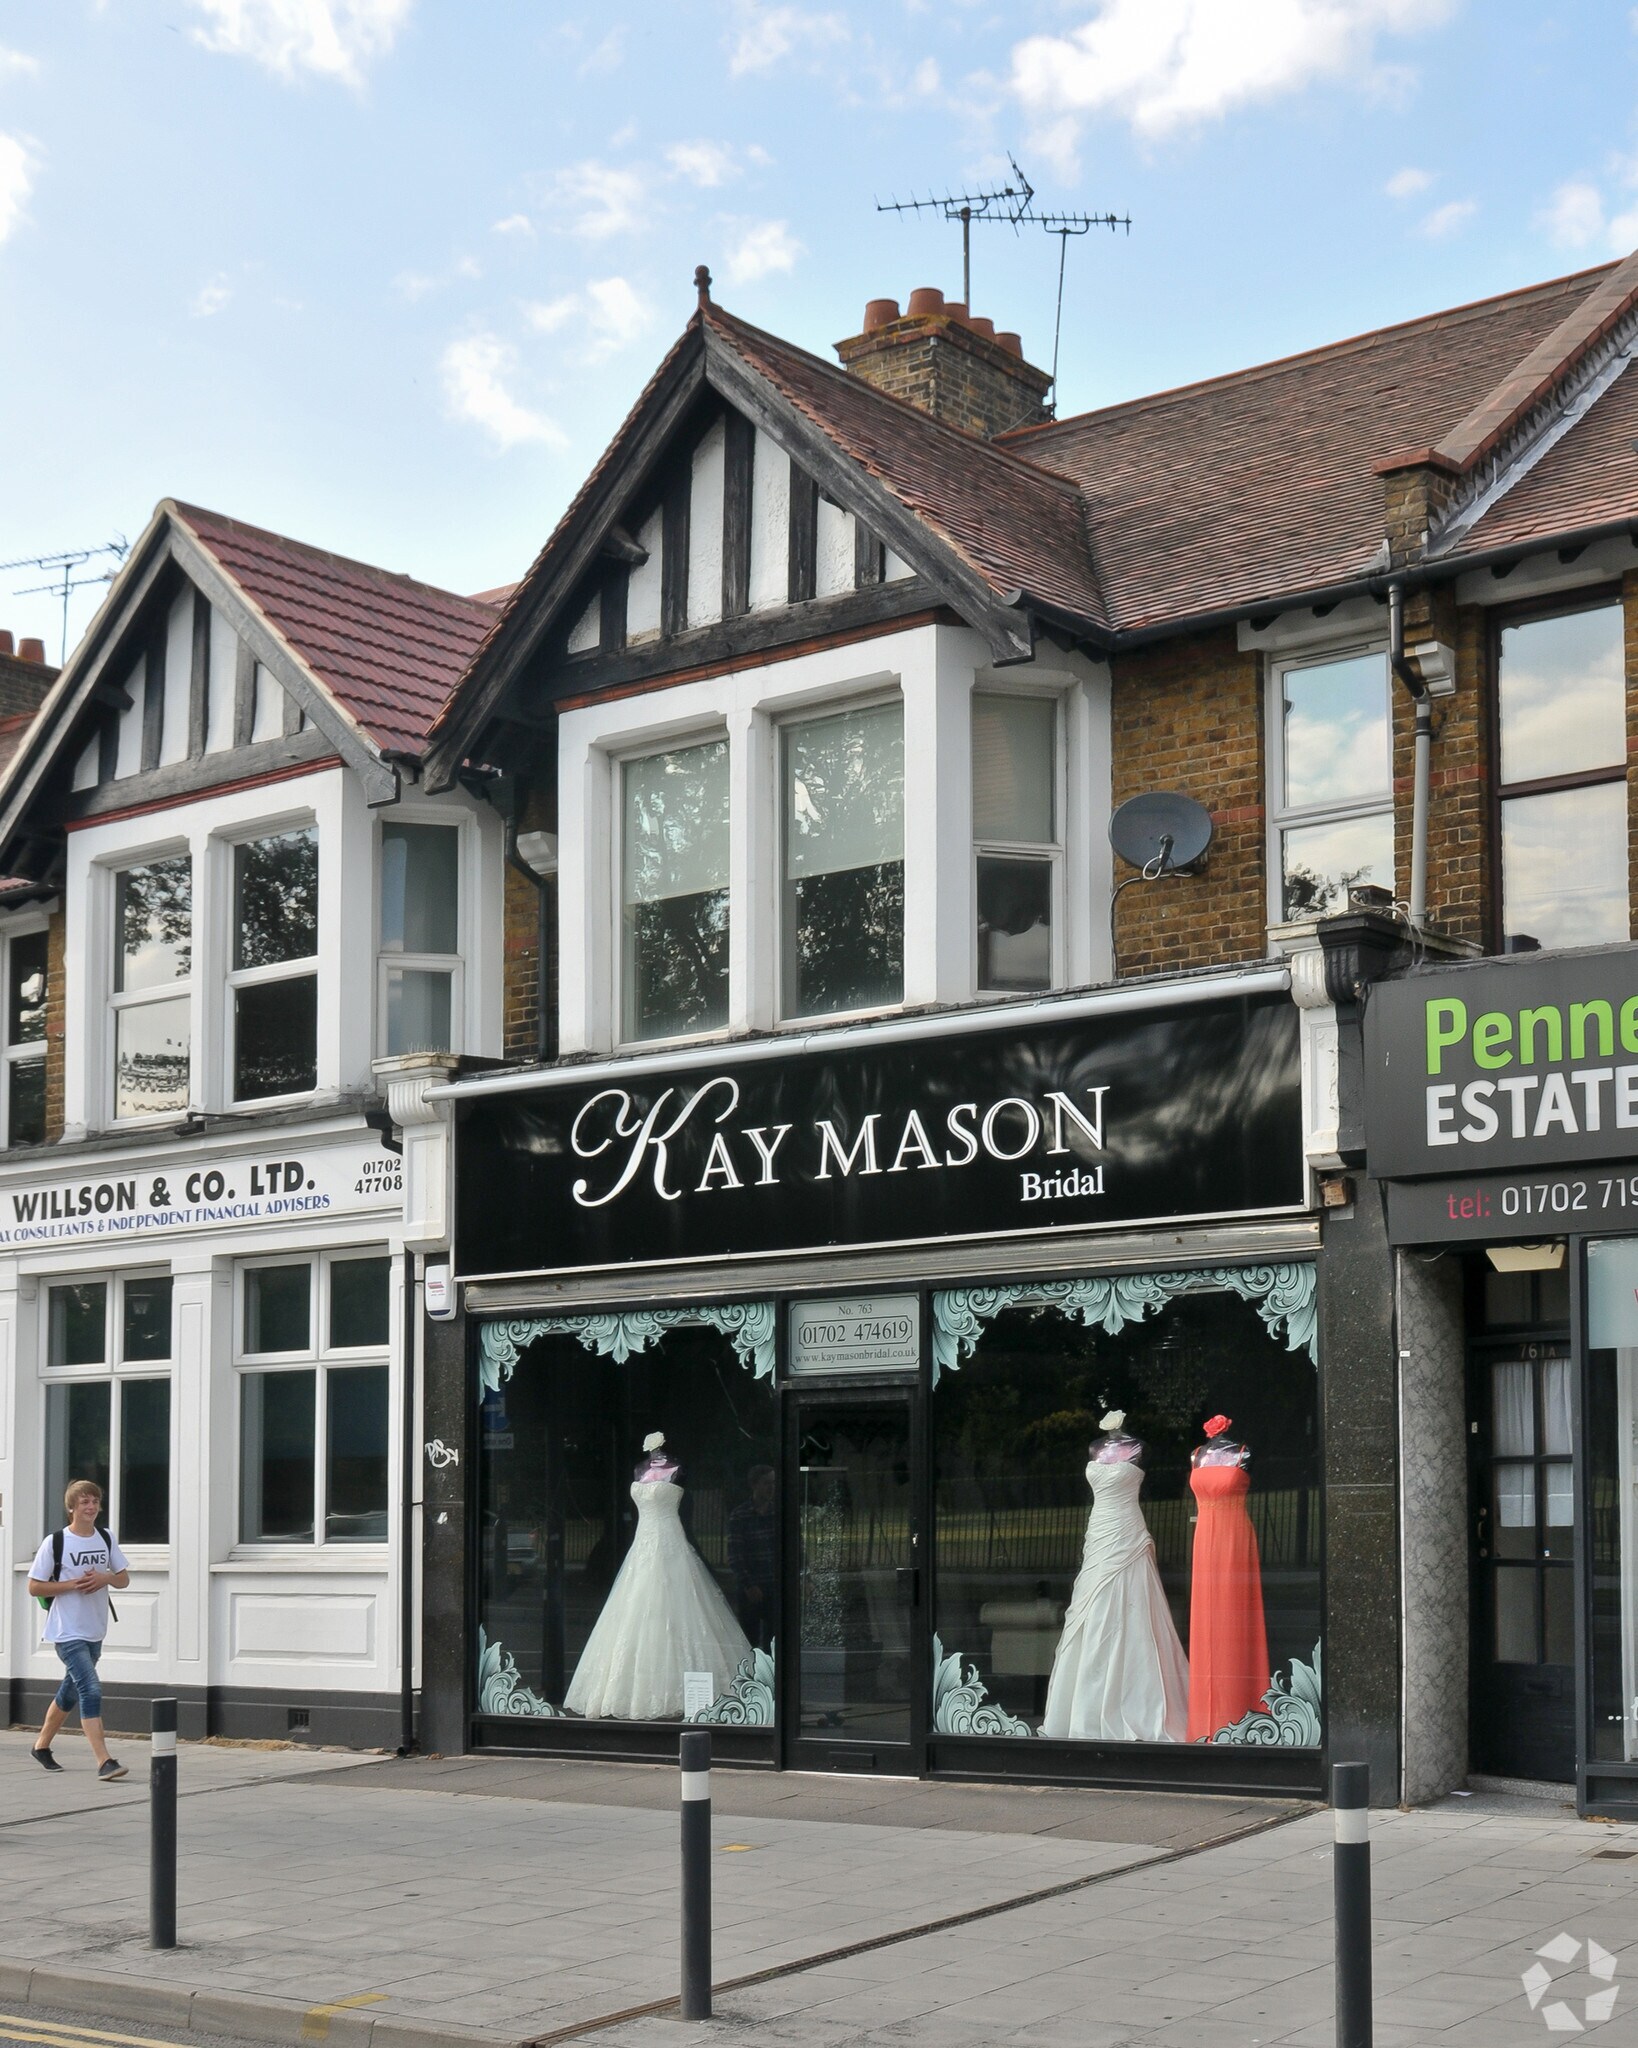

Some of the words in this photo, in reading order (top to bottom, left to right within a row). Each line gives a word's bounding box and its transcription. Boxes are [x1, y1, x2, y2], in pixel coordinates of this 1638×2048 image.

[1426, 1065, 1638, 1146] ESTATE
[814, 1086, 1111, 1181] MASON
[363, 1159, 401, 1175] 01702
[1020, 1165, 1105, 1201] Bridal
[13, 1181, 136, 1223] WILLSON
[149, 1177, 172, 1207] &
[186, 1171, 236, 1204] CO.
[250, 1161, 315, 1196] LTD.
[1447, 1188, 1491, 1219] tel:
[1501, 1181, 1588, 1216] 01702
[14, 1220, 94, 1241] CONSULTANTS
[97, 1219, 104, 1232] &
[108, 1210, 192, 1231] INDEPENDENT
[196, 1202, 261, 1221] FINANCIAL
[264, 1193, 331, 1214] ADVISERS
[838, 1306, 854, 1316] No.
[858, 1303, 873, 1314] 763
[803, 1325, 845, 1344] 01702
[854, 1320, 908, 1340] 474619
[795, 1347, 917, 1363] www.kaymasonbridal.co.uk
[69, 1550, 106, 1566] VANS
